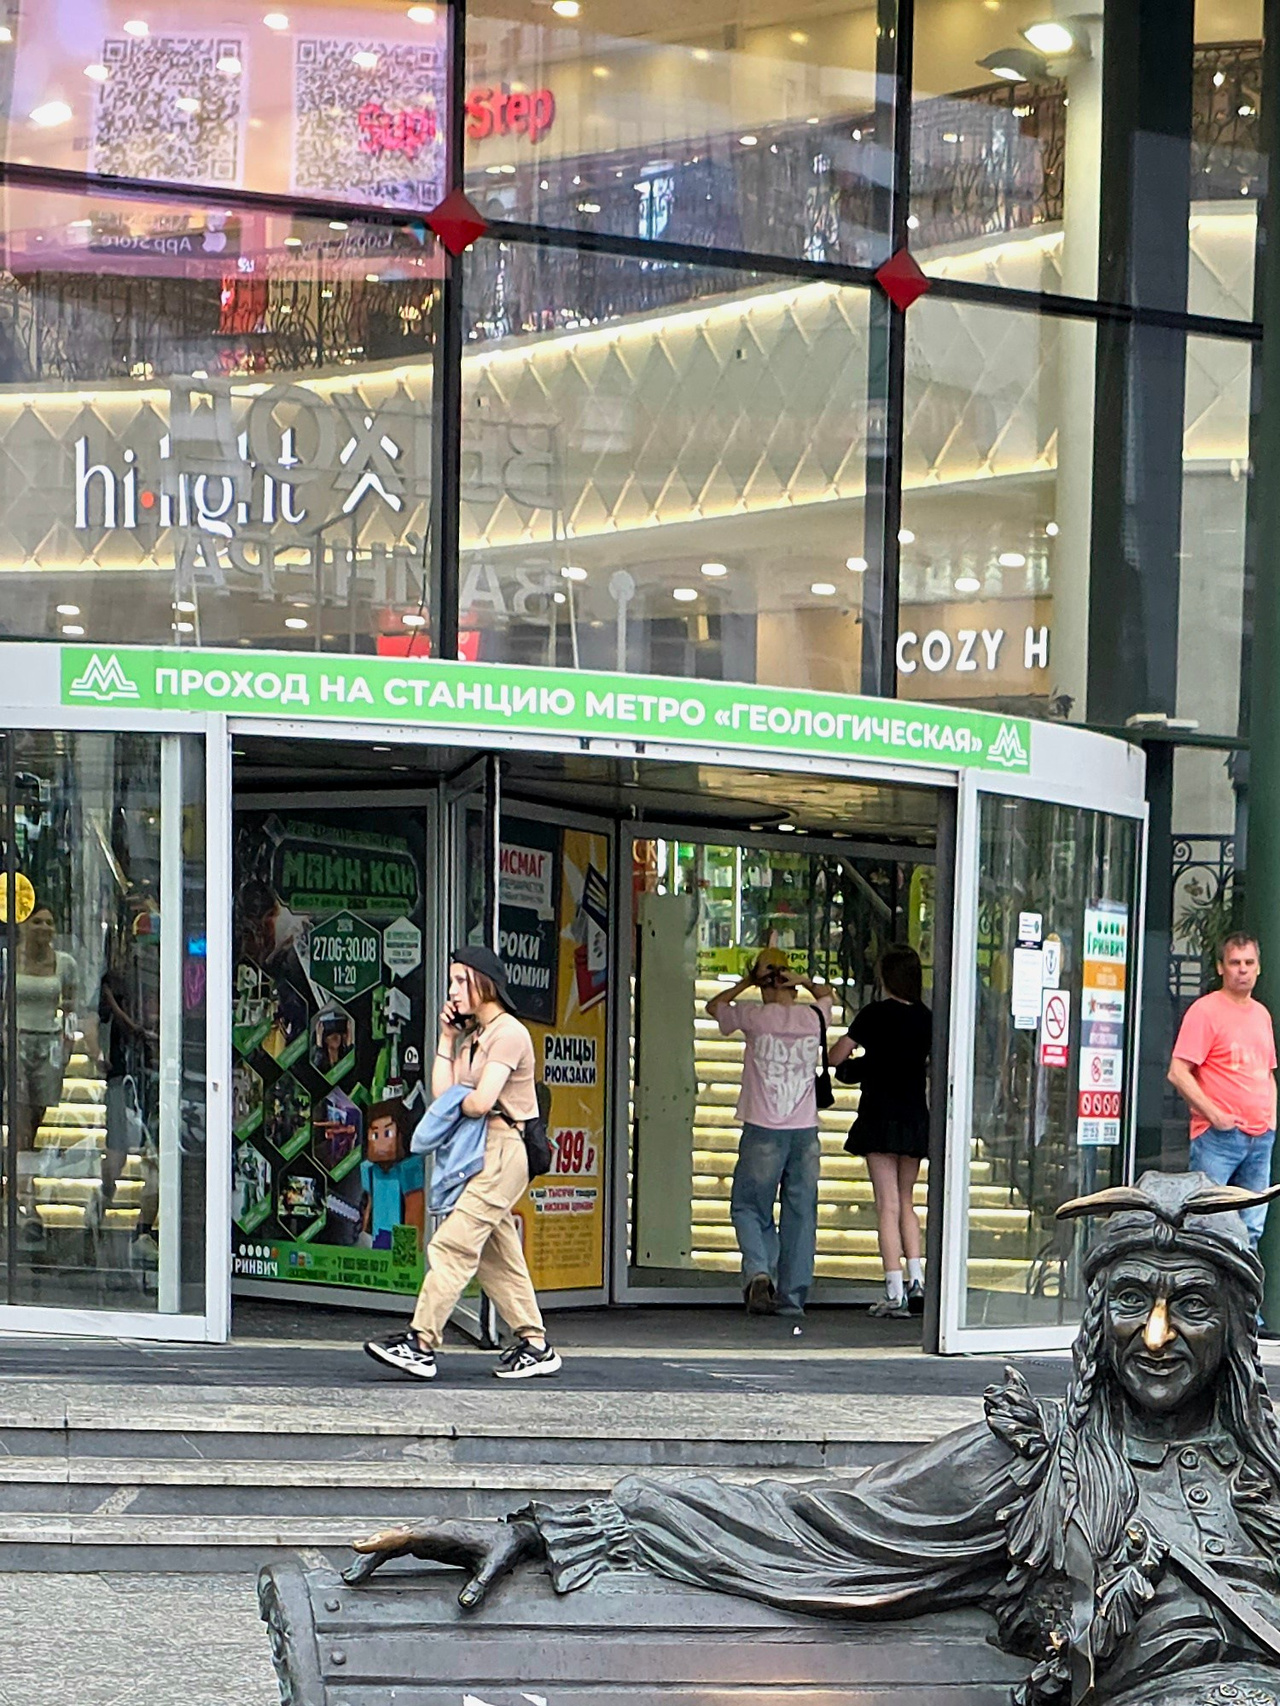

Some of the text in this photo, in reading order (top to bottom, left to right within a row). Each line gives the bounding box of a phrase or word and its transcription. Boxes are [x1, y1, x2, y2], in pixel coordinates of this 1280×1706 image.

[896, 628, 1004, 673] COZY
[155, 667, 310, 705] ПРОХОД
[319, 674, 375, 705] НА
[383, 678, 576, 717] СТАНЦИЮ
[585, 690, 706, 726] МЕТРО
[714, 703, 983, 753] «ГЕОЛОГИЧЕСКАЯ»
[500, 849, 545, 879] ИСМАГ
[313, 936, 376, 962] 27.06-30.08
[500, 931, 540, 960] РОКИ
[333, 965, 357, 985] 11-20
[503, 963, 550, 989] НОМИИ
[545, 1036, 596, 1065] РАНЦЫ
[545, 1065, 596, 1084] РЮКЗАКИ
[555, 1130, 584, 1174] 199
